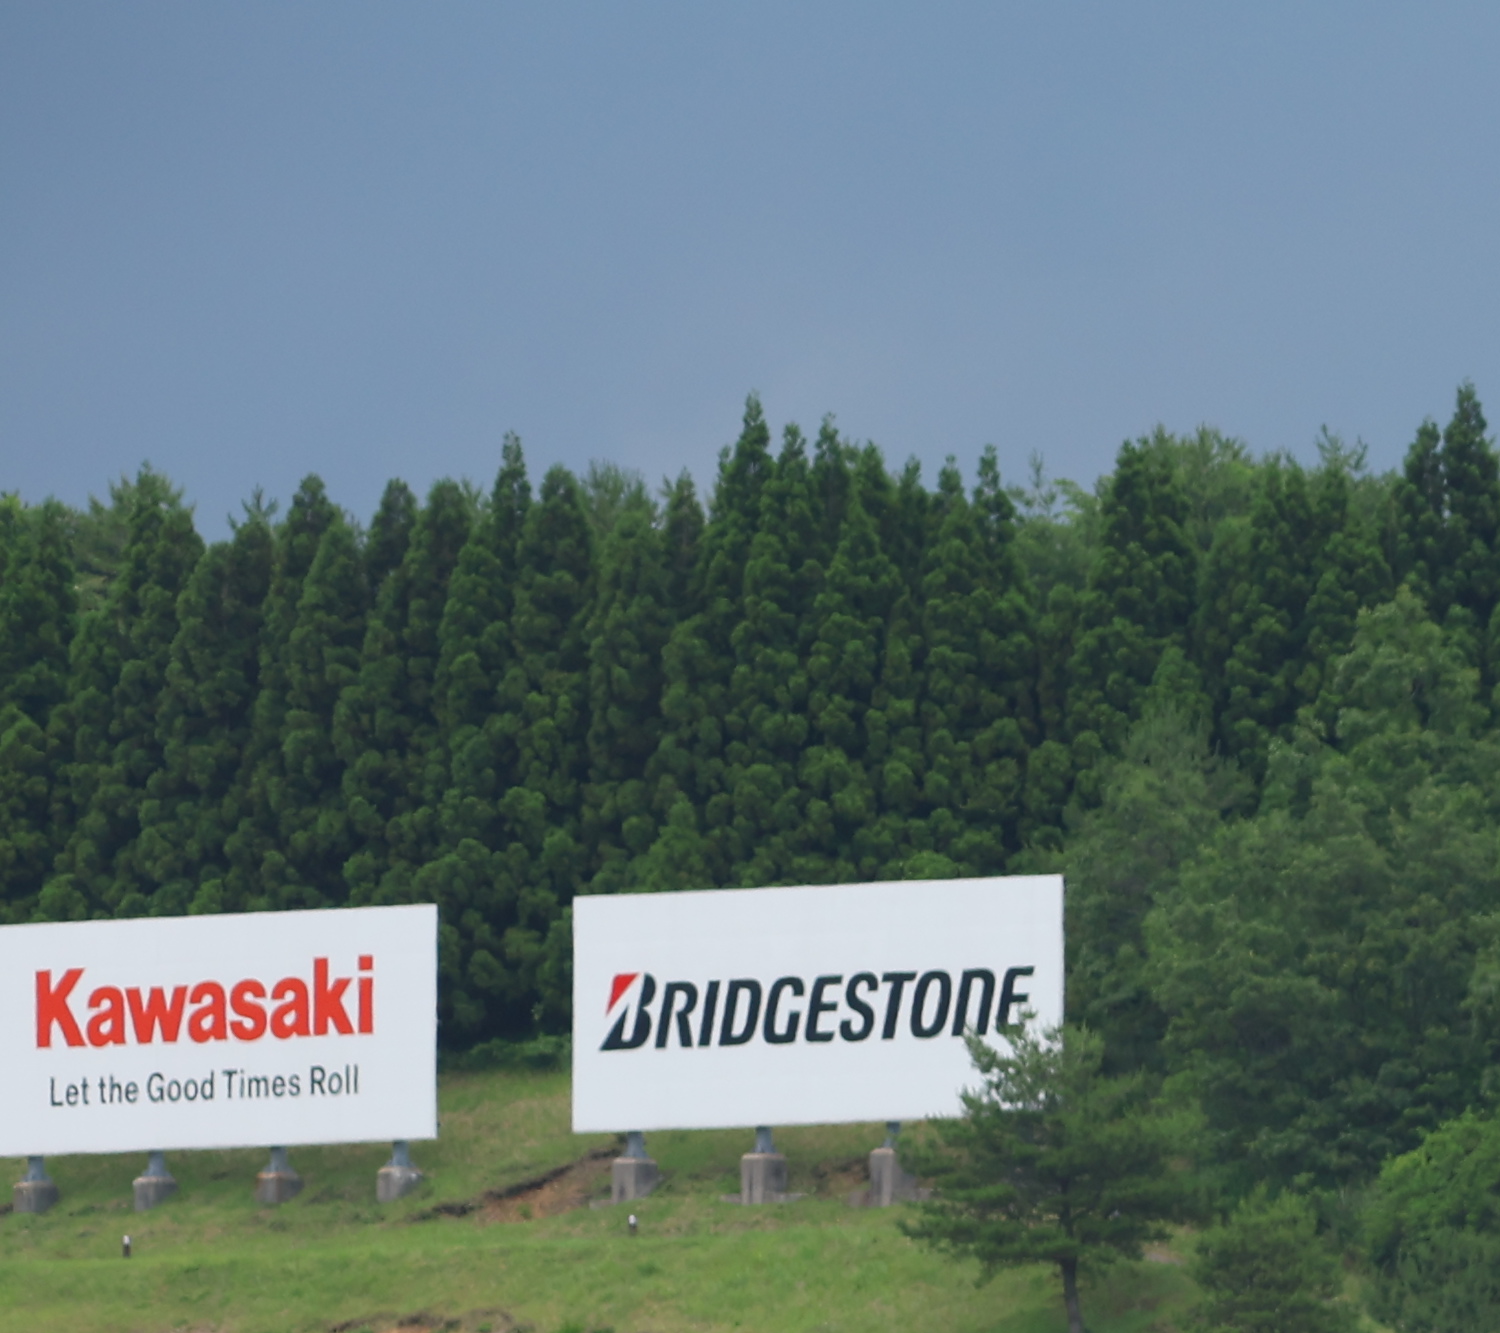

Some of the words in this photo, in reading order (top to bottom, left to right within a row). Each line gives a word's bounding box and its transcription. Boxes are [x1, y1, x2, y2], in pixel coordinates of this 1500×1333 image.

[35, 955, 374, 1049] Kawasaki
[599, 965, 1036, 1051] BRIDGESTONE
[50, 1077, 90, 1107] Let
[98, 1075, 139, 1105] the
[146, 1070, 215, 1102] Good
[222, 1068, 301, 1100] Times
[310, 1064, 359, 1096] Roll
